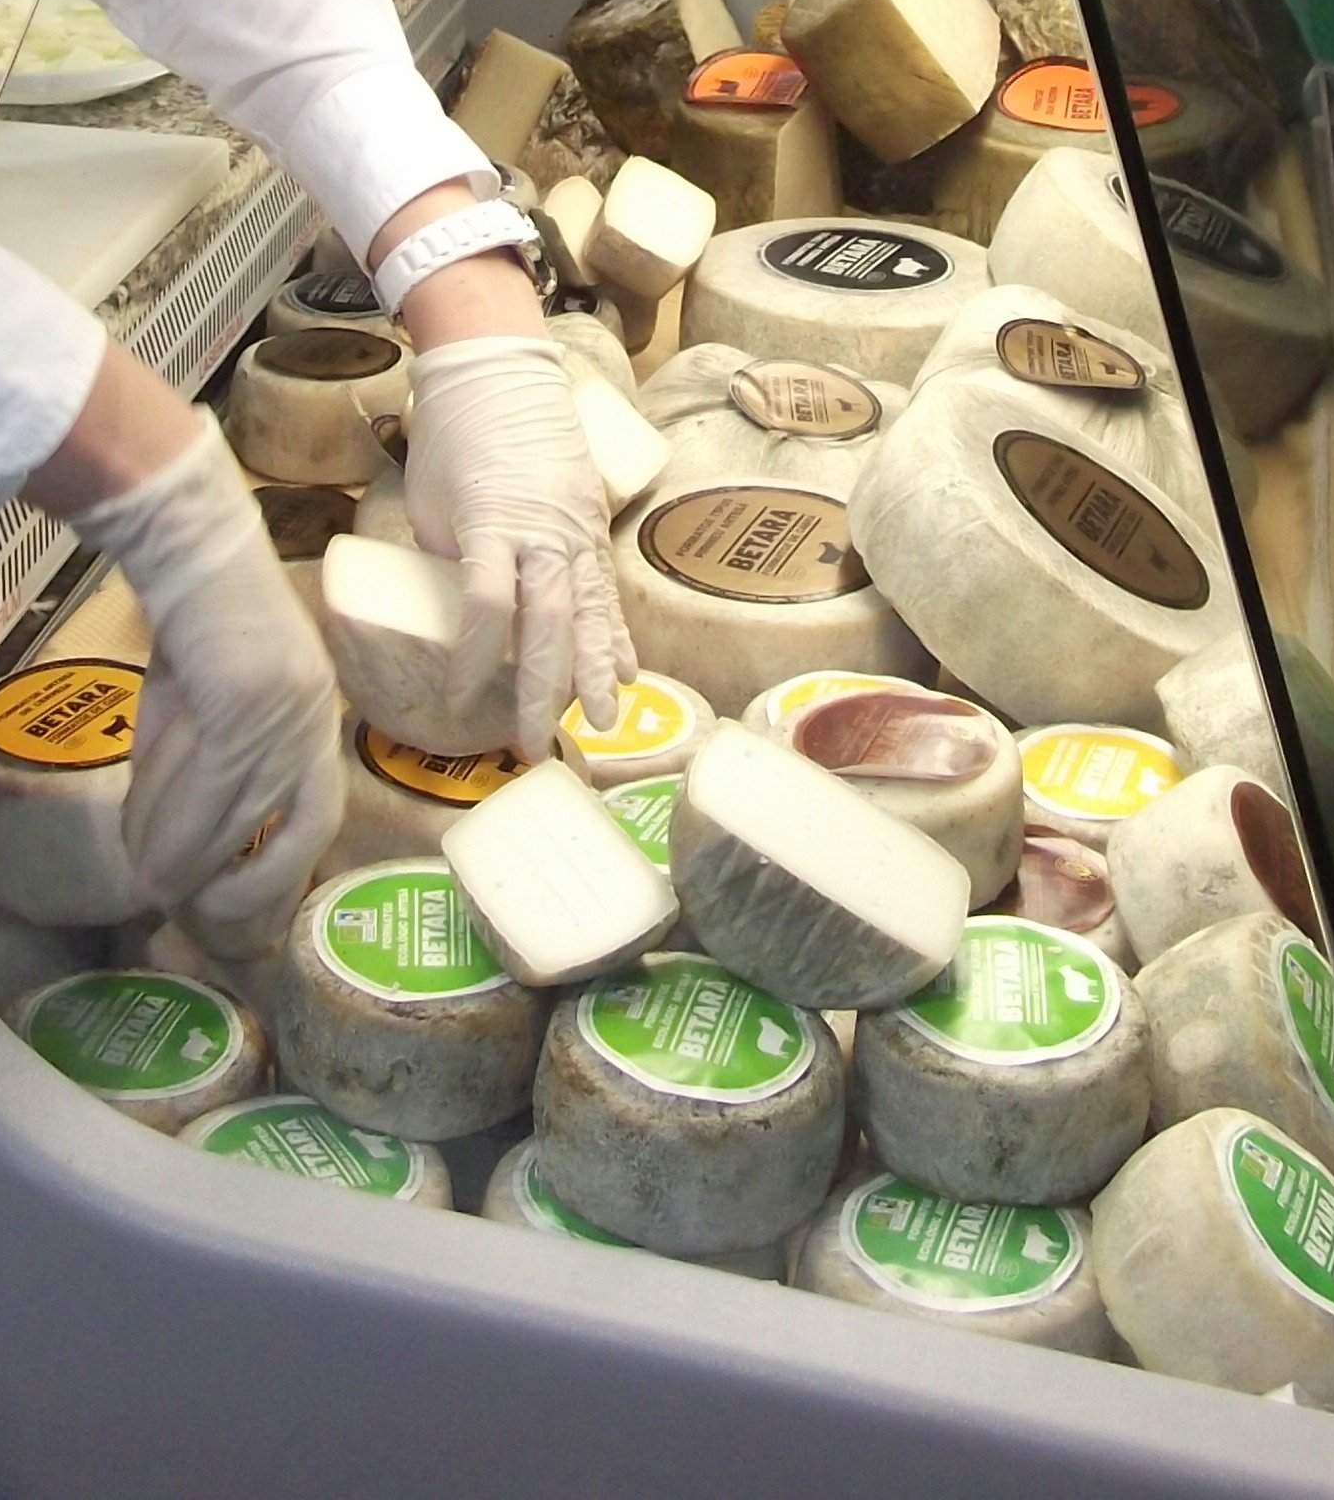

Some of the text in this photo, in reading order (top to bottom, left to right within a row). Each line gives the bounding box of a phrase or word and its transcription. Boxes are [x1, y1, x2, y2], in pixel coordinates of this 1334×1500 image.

[820, 238, 883, 275] BETARA
[793, 378, 813, 422] BETARA
[726, 509, 797, 572] BETARA
[1074, 488, 1122, 542] BETARA
[24, 683, 118, 738] BETARA
[422, 890, 447, 967] BETARA
[993, 941, 1023, 1022] BETARA
[100, 995, 170, 1067] BETARA
[677, 980, 730, 1060] BETARA
[942, 1203, 992, 1270] BETAR
